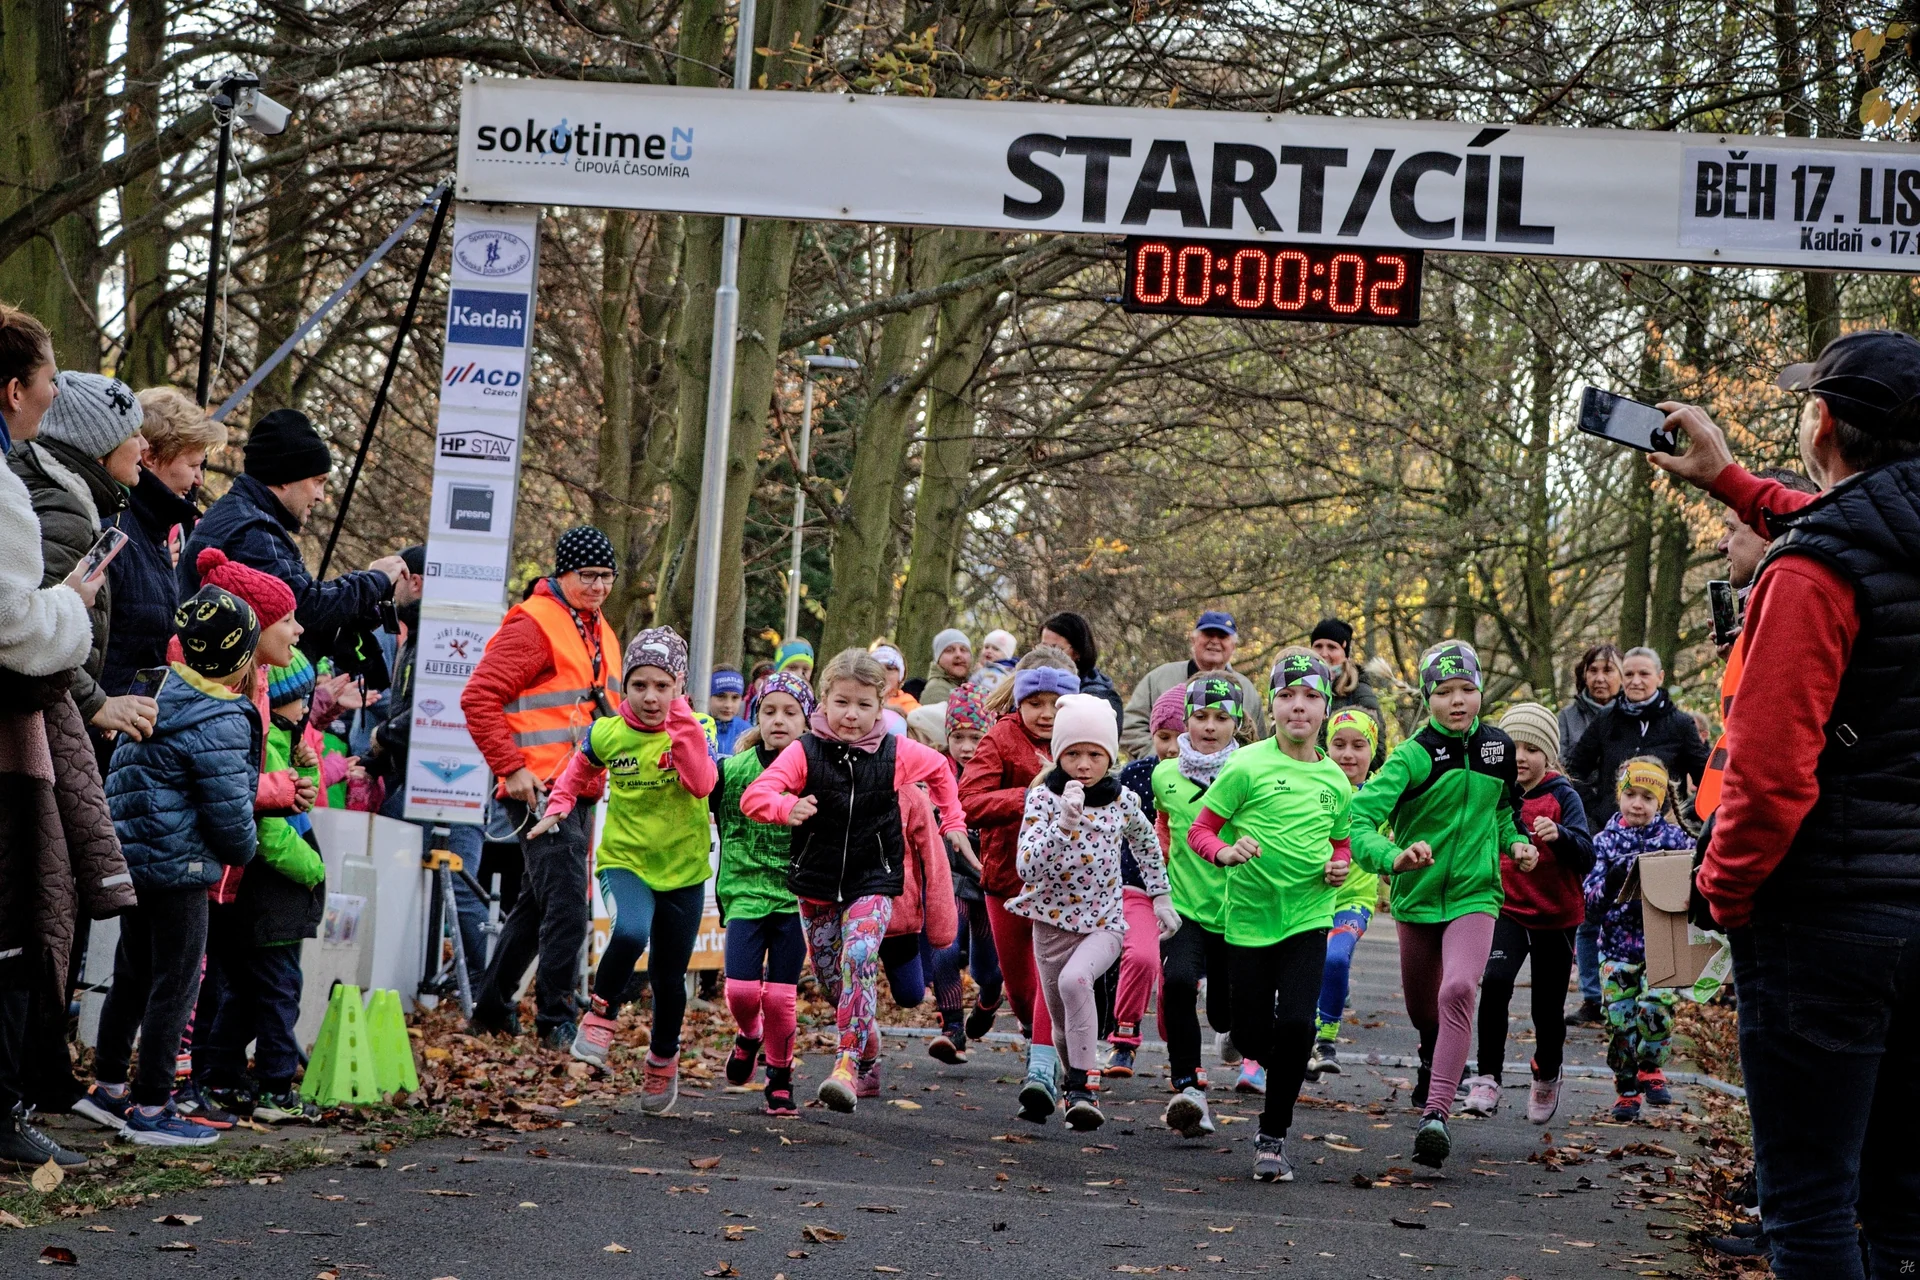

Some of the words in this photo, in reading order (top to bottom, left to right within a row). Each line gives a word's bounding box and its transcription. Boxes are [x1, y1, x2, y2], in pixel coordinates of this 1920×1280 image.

[574, 157, 621, 175] ČIPOVÁ
[623, 159, 690, 178] ČASOMÍRA
[1002, 128, 1556, 245] START/CÍL
[1694, 150, 1778, 221] BĚH
[1791, 164, 1845, 224] 17.
[1858, 167, 1920, 227] LIS
[1800, 226, 1863, 253] Kadaň
[1134, 243, 1406, 316] 00:00:02
[452, 305, 523, 330] Kadaň
[470, 367, 522, 387] ACD
[483, 387, 518, 398] Czech
[441, 436, 467, 451] HP
[471, 438, 513, 455] STAV
[1480, 744, 1505, 758] OSTROV
[438, 755, 461, 771] SD
[607, 756, 639, 769] TEMA
